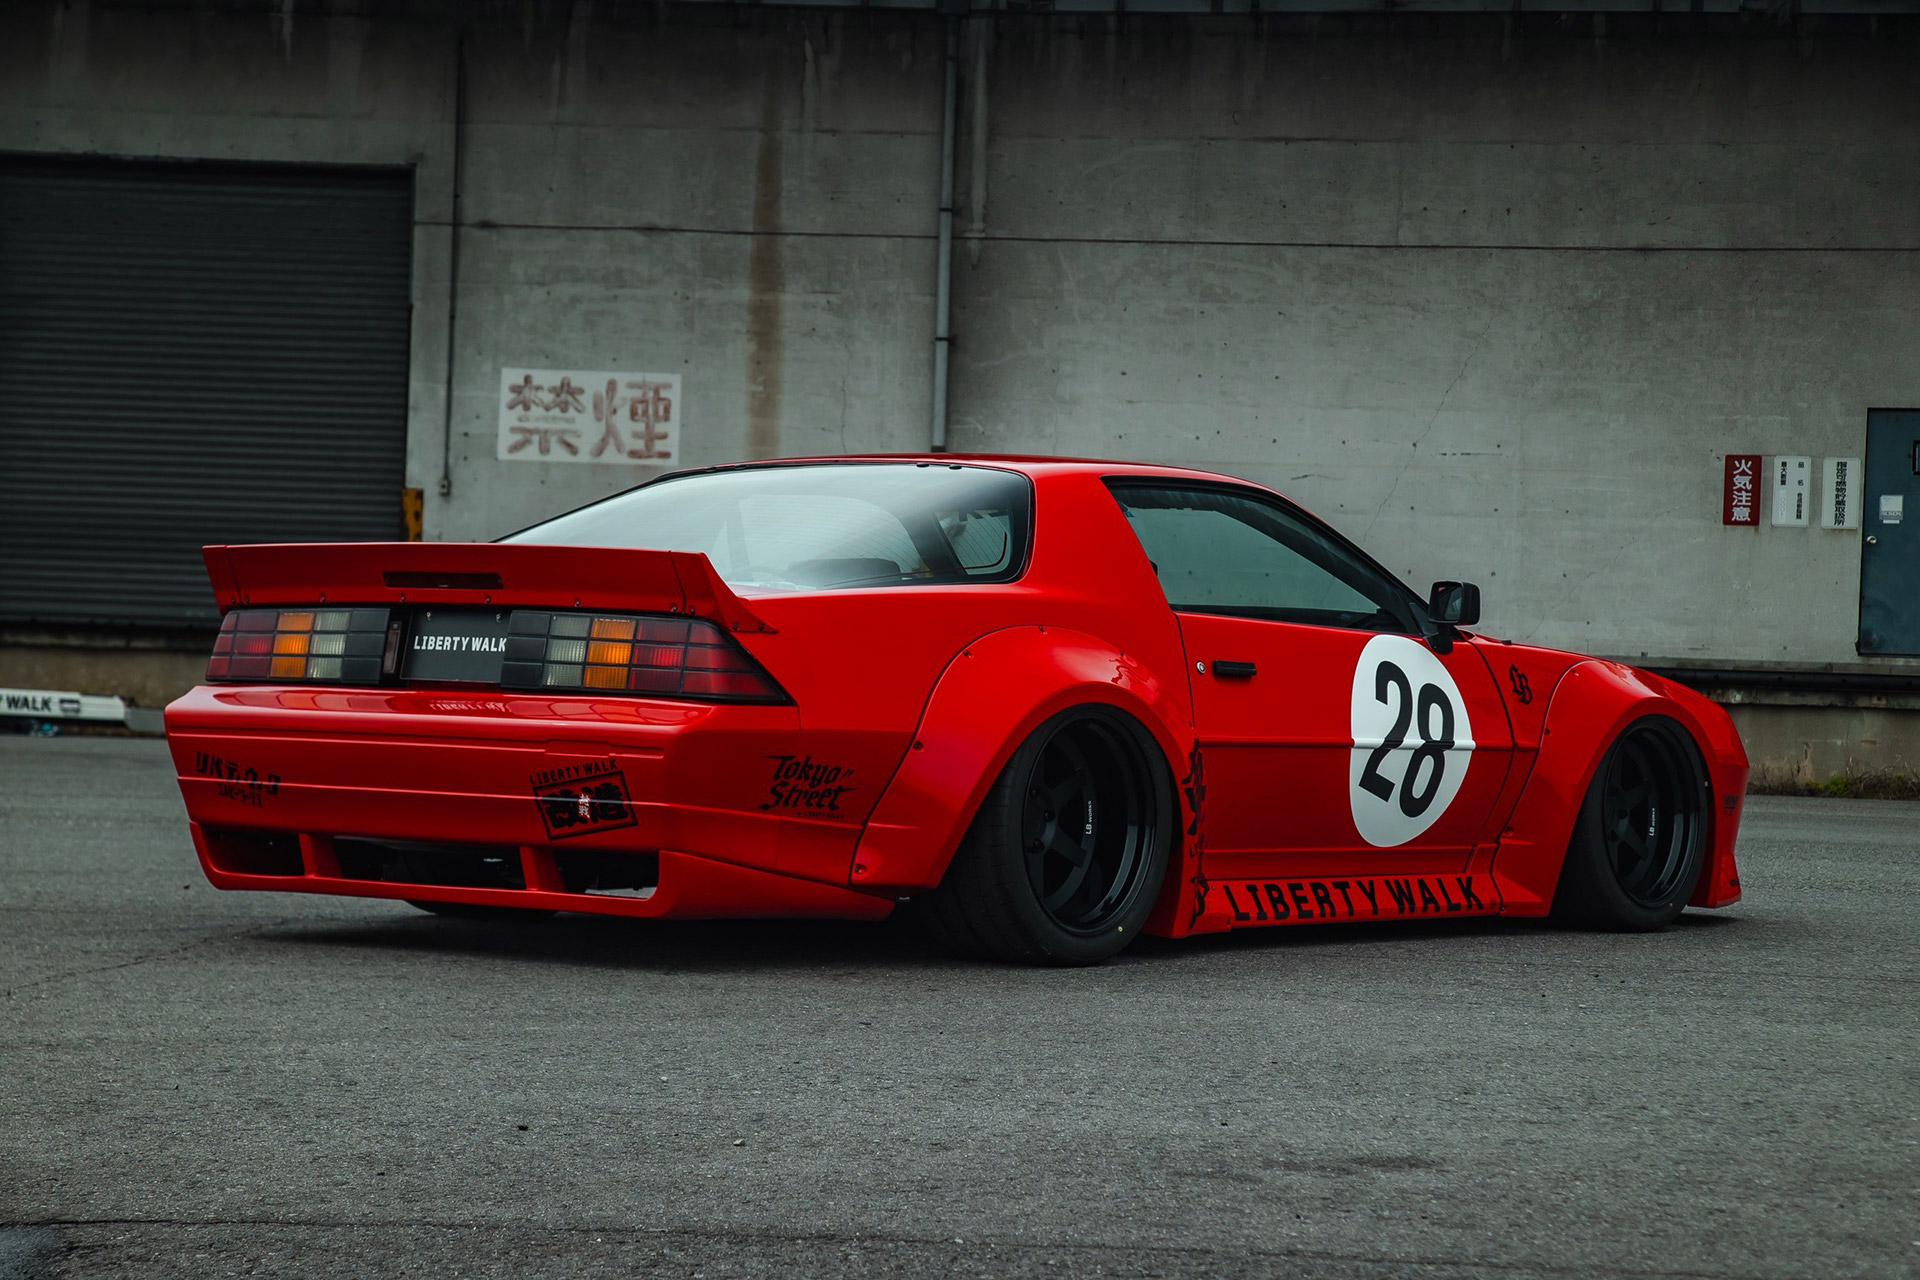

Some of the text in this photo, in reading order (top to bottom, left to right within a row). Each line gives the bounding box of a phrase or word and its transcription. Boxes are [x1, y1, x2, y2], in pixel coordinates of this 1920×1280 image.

[507, 374, 672, 459] 禁煙
[1731, 459, 1753, 522] 火気注意
[413, 635, 507, 652] LIBERTY WALK
[6, 694, 51, 712] WALK
[1358, 660, 1455, 818] 28
[529, 758, 618, 786] LIBERTY WALK
[761, 754, 843, 788] Tokyo
[758, 781, 859, 811] Street
[1085, 823, 1092, 835] LB
[1223, 876, 1484, 921] LIBERTY WALK
